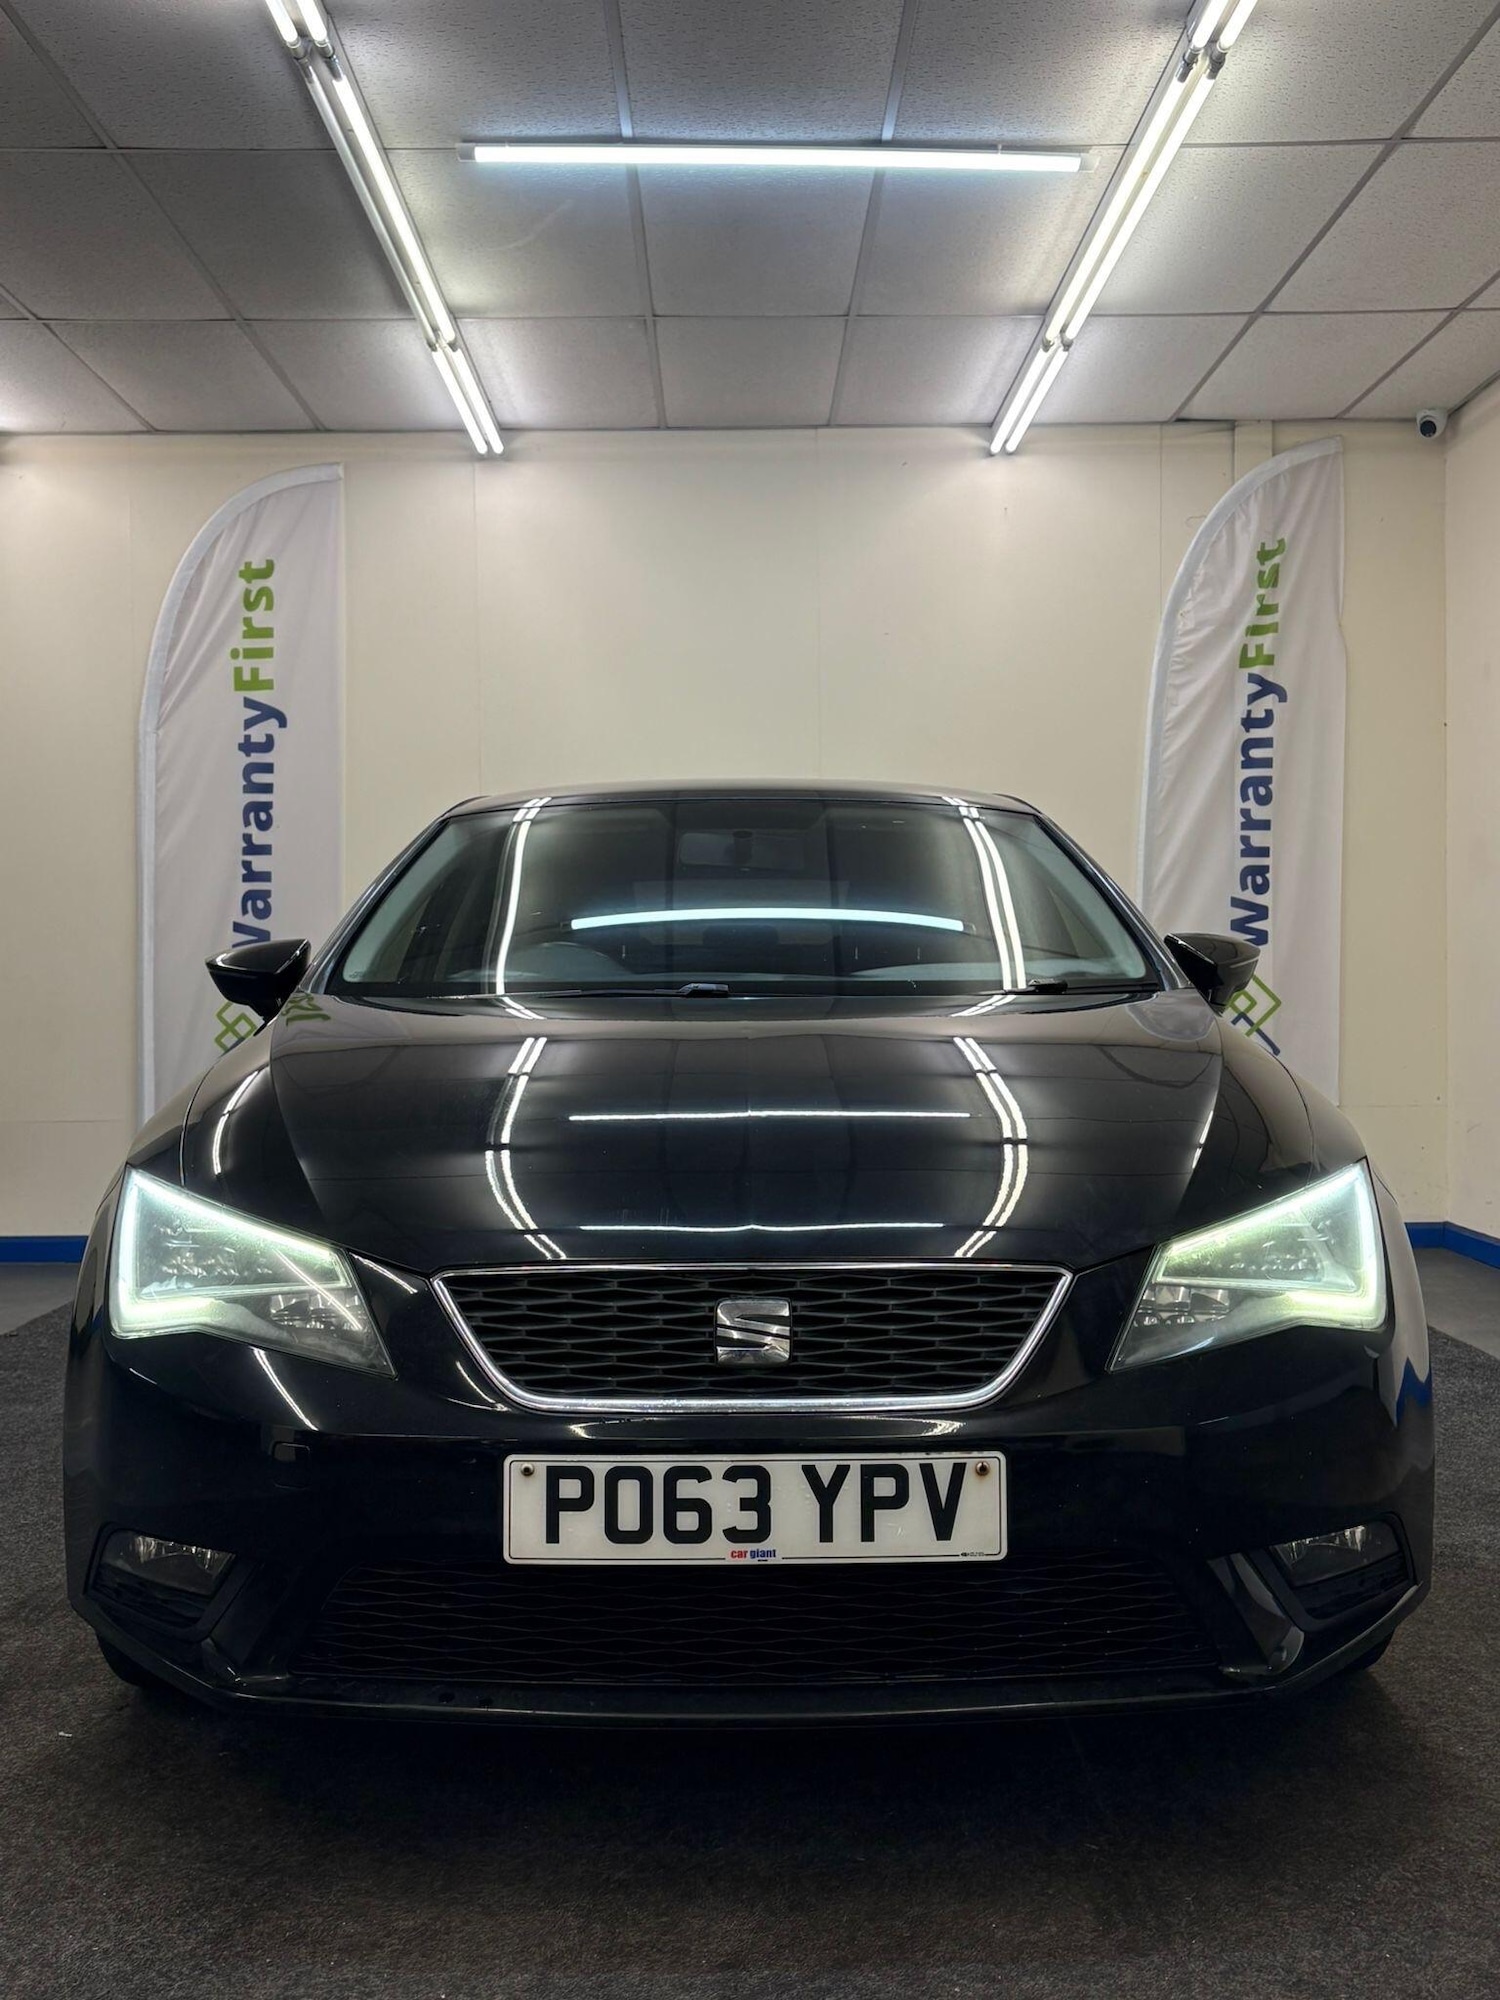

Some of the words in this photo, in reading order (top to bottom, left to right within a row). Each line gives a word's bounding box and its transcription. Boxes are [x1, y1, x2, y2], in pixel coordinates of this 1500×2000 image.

[545, 1464, 772, 1545] PO63
[801, 1462, 968, 1543] YPV
[730, 1549, 748, 1559] car
[749, 1548, 777, 1560] giant
